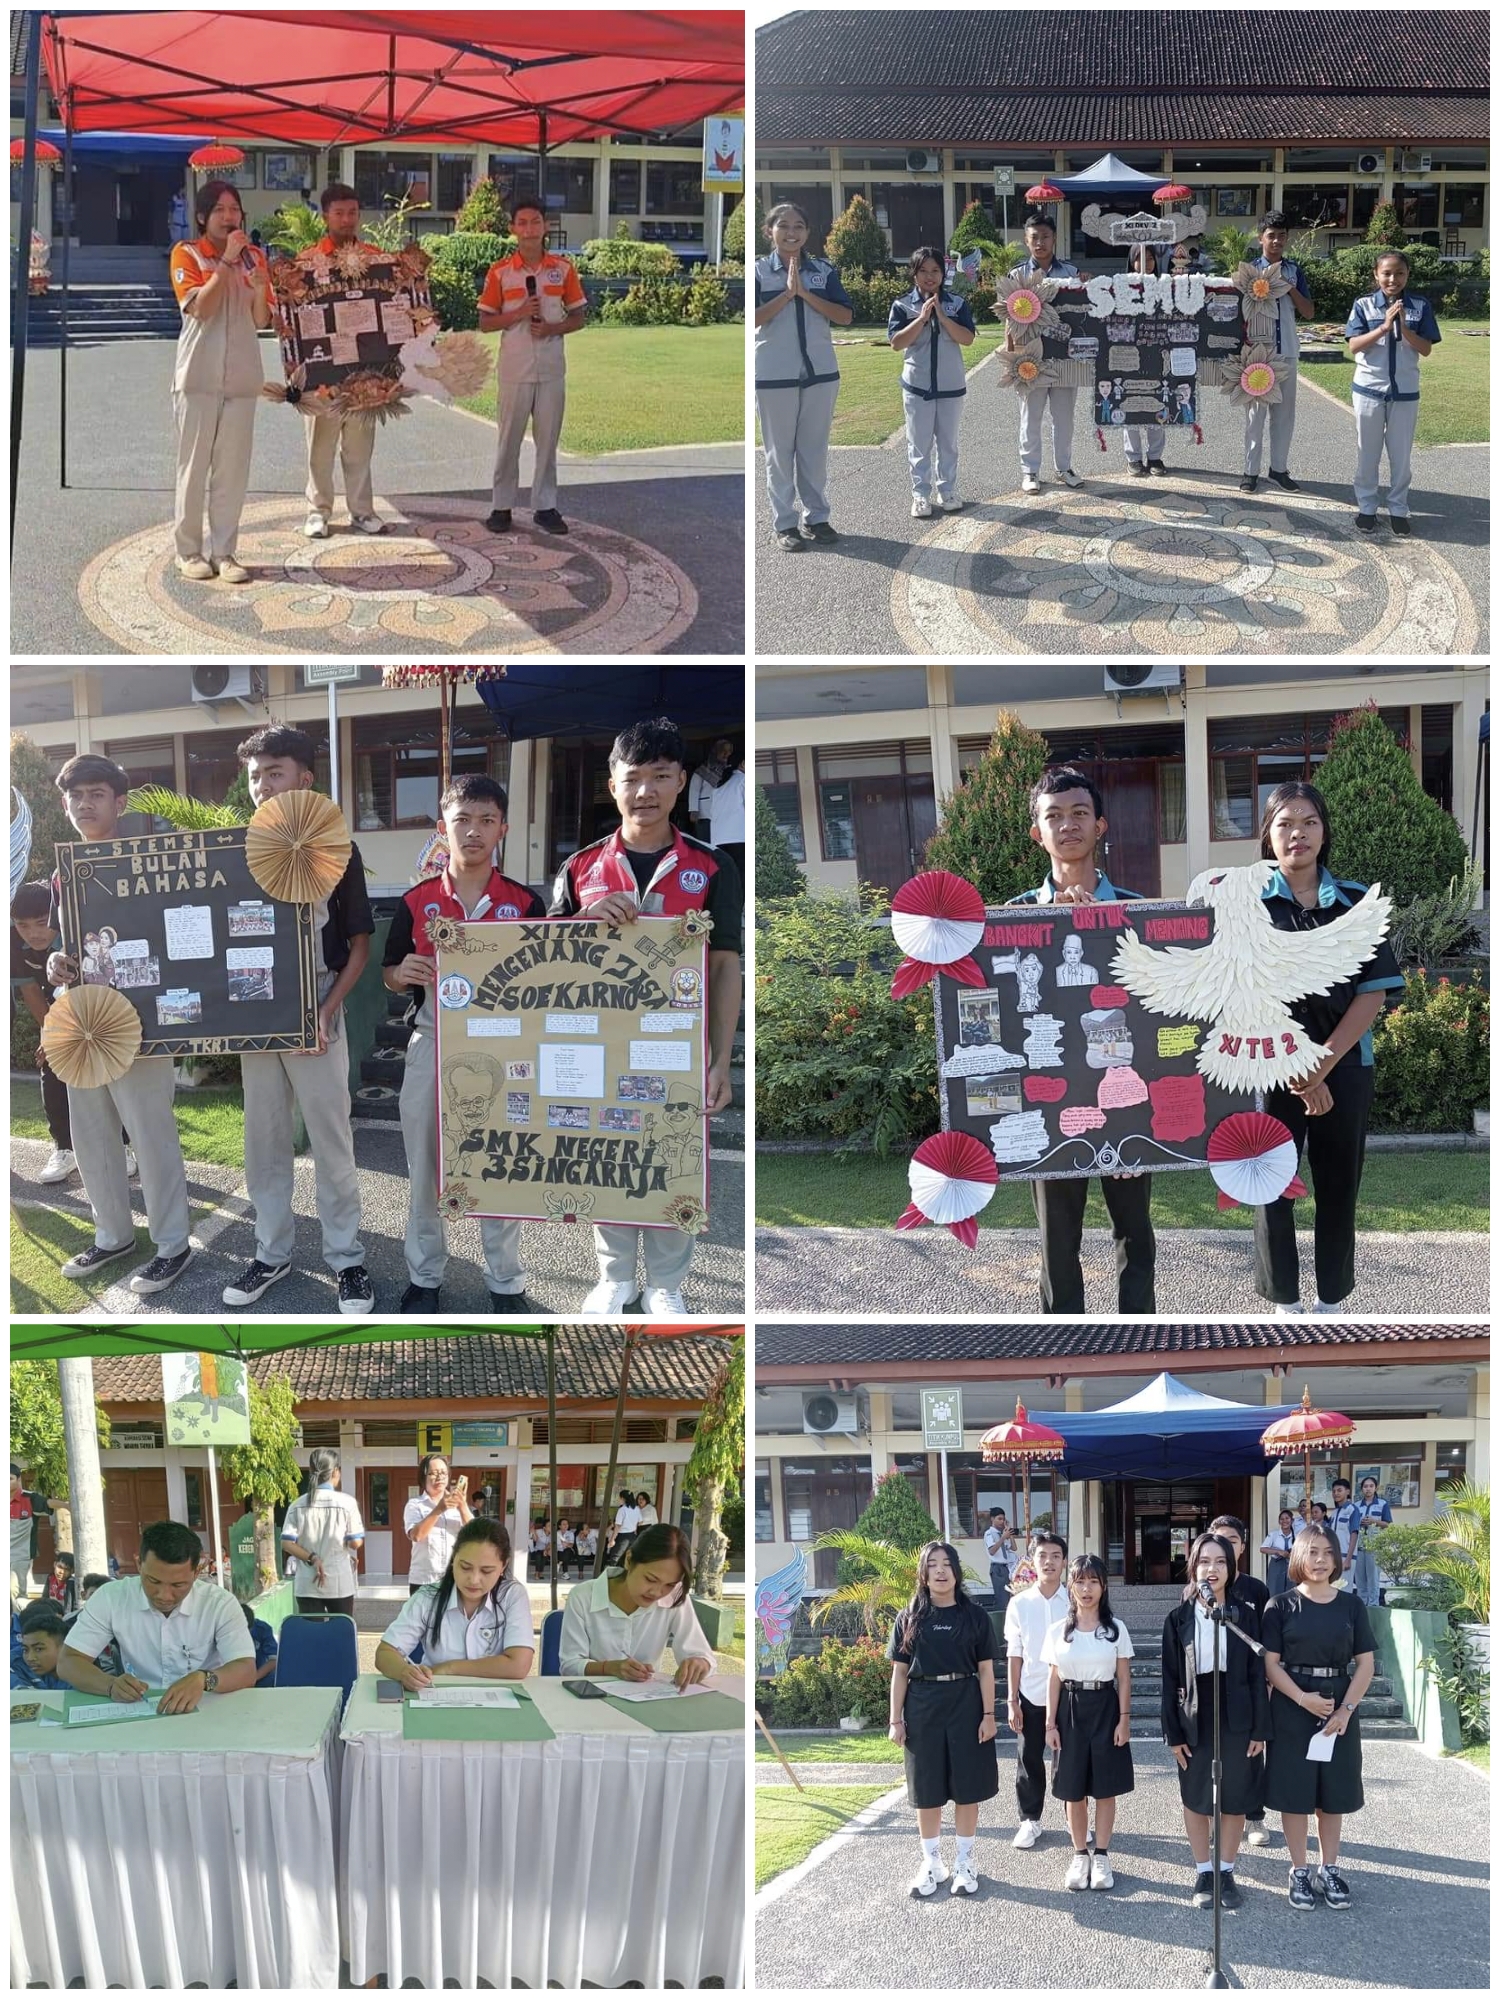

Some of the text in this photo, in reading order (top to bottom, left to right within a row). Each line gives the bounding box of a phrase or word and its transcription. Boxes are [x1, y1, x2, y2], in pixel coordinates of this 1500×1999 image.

[1087, 272, 1205, 319] SEMU
[112, 833, 205, 857] STEMSI
[131, 851, 207, 875] BULAN
[116, 870, 227, 897] BAHASA
[556, 922, 598, 938] TKR
[984, 904, 1210, 947] BANGKIT UNTUK MENANG
[471, 939, 613, 1011] MENGENANG
[498, 980, 639, 1011] SOEKARNO
[1219, 1033, 1242, 1057] XI
[1246, 1037, 1276, 1059] TE
[1281, 1032, 1298, 1056] 2
[459, 1128, 541, 1157] SMK
[426, 1425, 442, 1452] E
